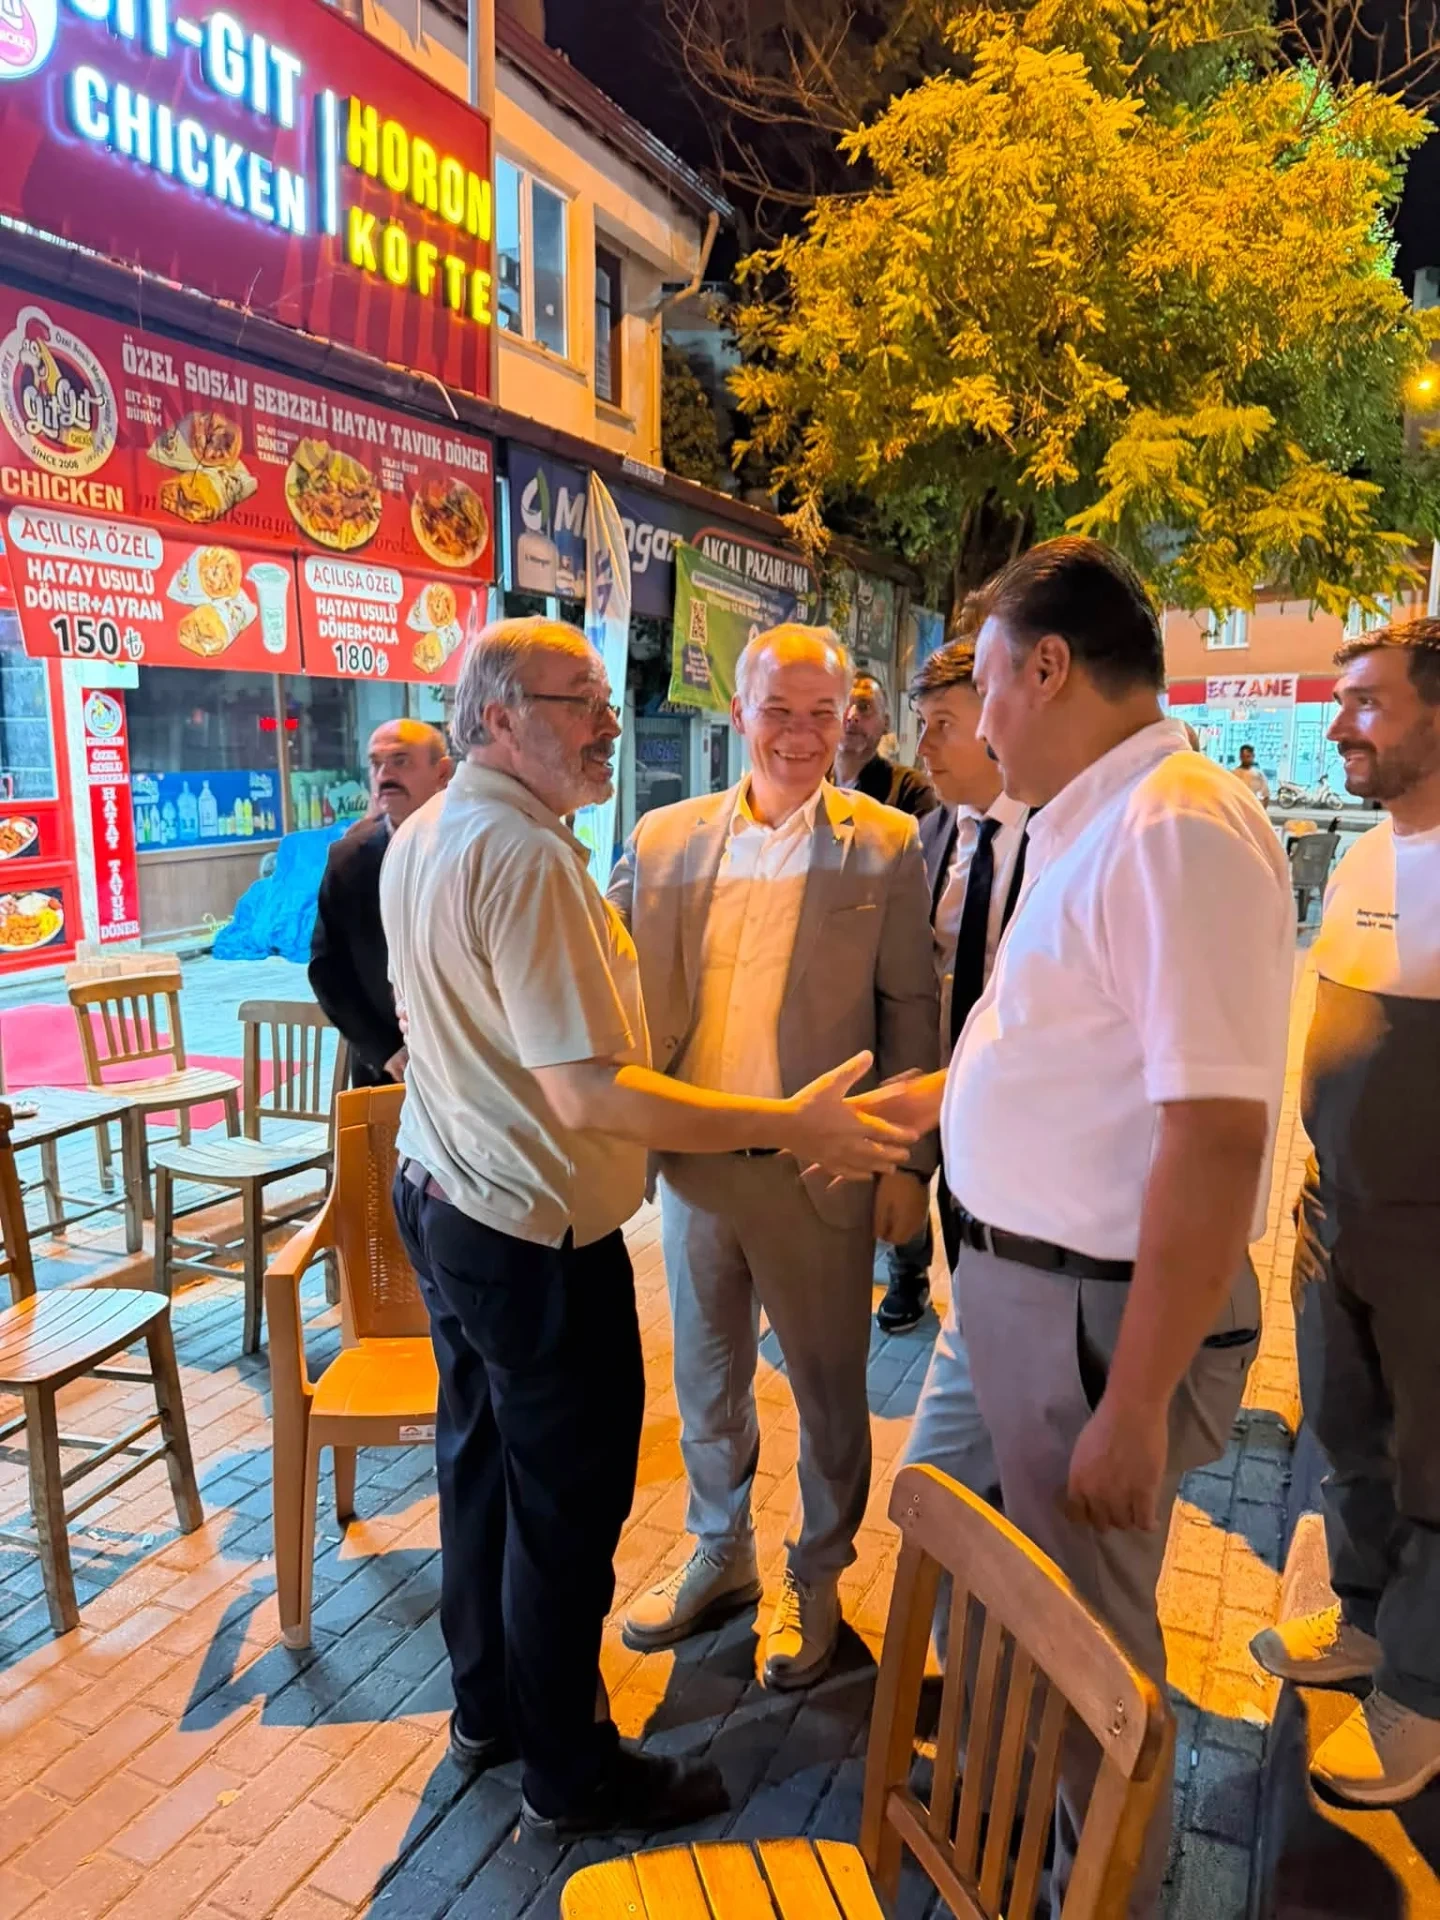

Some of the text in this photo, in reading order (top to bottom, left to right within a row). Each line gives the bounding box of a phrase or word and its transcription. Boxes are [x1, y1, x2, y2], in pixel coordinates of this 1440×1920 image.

[62, 0, 302, 129] IT-GIT
[71, 66, 305, 235] CHICKEN
[346, 95, 493, 242] HORON
[346, 205, 493, 325] KÖFTE
[122, 334, 180, 388] ÖZEL
[184, 361, 249, 407] SOSLU
[253, 382, 329, 429] SEBZELİ
[332, 405, 388, 446] HATAY
[390, 424, 443, 464] TAVUK
[445, 436, 489, 474] DÖNER
[31, 445, 56, 466] SINCE
[1, 466, 124, 512] CHICKEN
[21, 517, 156, 560] AÇILIŞA ÖZEL
[26, 557, 156, 596] HATAY USULÜ
[313, 564, 398, 595] AÇILIŞA ÖZEL
[745, 548, 809, 594] PAZARLAMA
[24, 581, 165, 621] DÖNER+AYRAN
[316, 597, 398, 624] HATAY USULÜ
[52, 617, 120, 656] 150
[318, 619, 399, 645] DÖNER+COLA
[334, 643, 374, 672] 180
[1208, 679, 1292, 698] ECZANE
